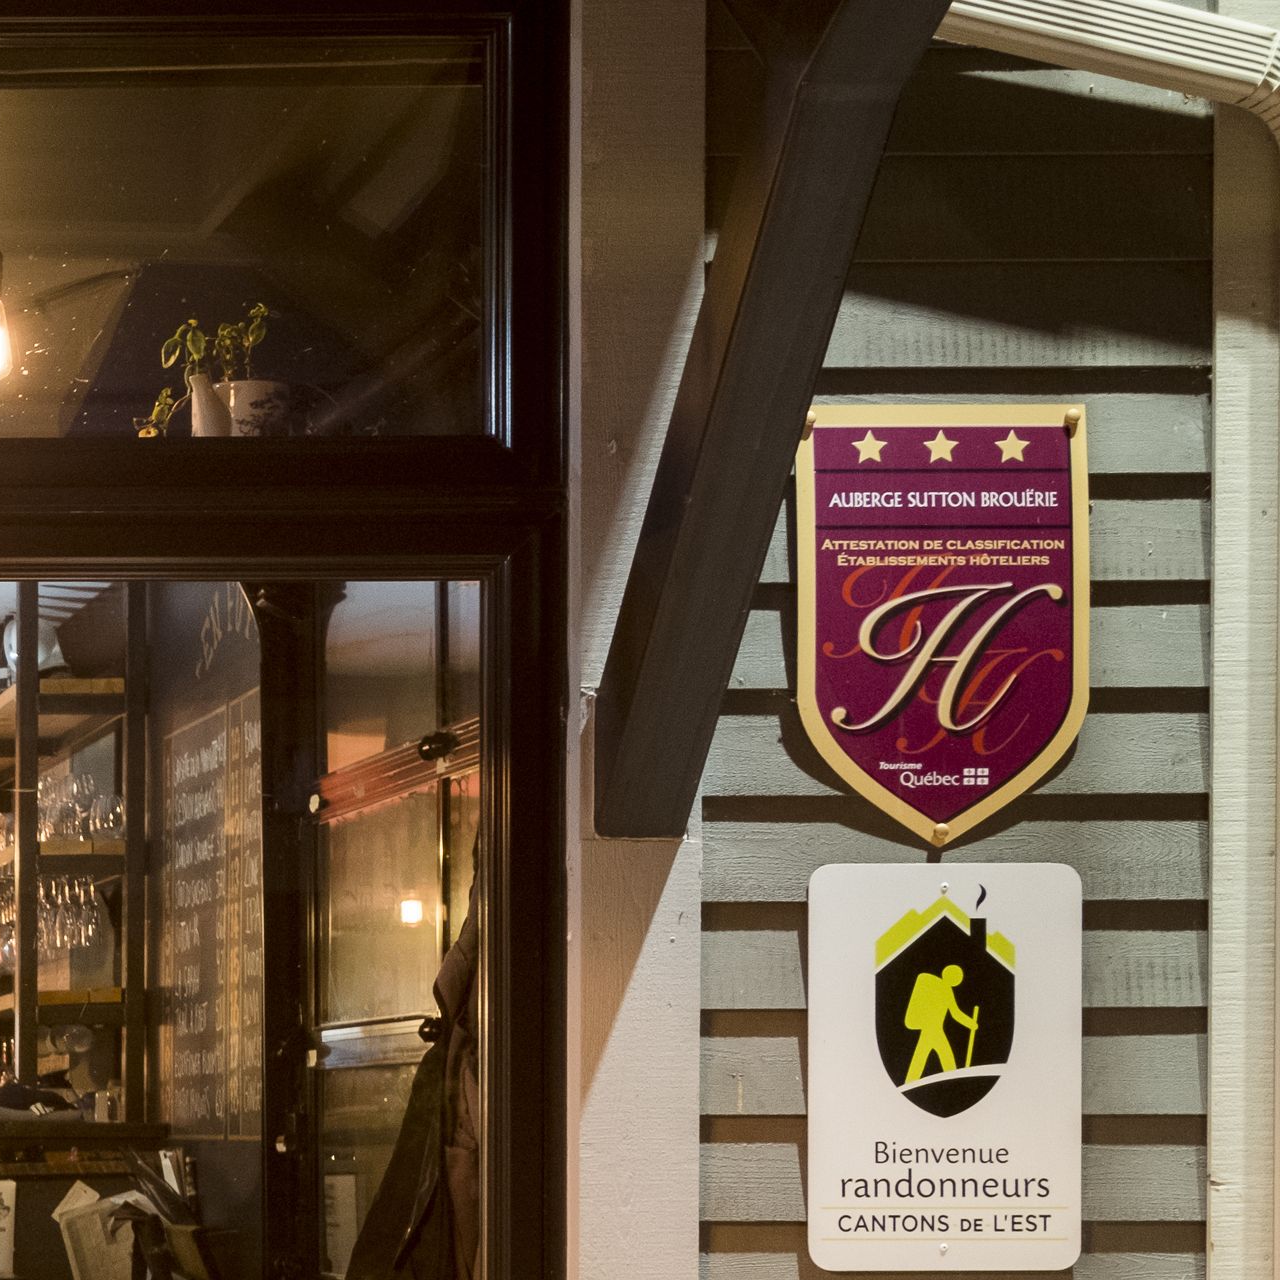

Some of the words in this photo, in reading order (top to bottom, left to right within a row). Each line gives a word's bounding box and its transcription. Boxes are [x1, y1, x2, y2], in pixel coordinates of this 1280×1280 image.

[828, 491, 903, 508] AUBERGE
[907, 491, 976, 508] SUTTON
[980, 488, 1059, 508] BROUËRIE
[821, 538, 920, 551] ATTESTATION
[923, 539, 944, 550] DE
[945, 539, 1065, 550] CLASSIFICATION
[837, 551, 966, 566] ÉTABLISSEMENTS
[969, 551, 1050, 566] HÔTELIERS
[879, 761, 923, 770] Tourisme
[899, 770, 960, 789] Québec
[874, 1141, 1009, 1164] Bienvenue
[841, 1167, 1050, 1198] randonneurs
[838, 1214, 950, 1233] CANTONS
[960, 1218, 984, 1232] DE
[993, 1214, 1052, 1233] L'EST
